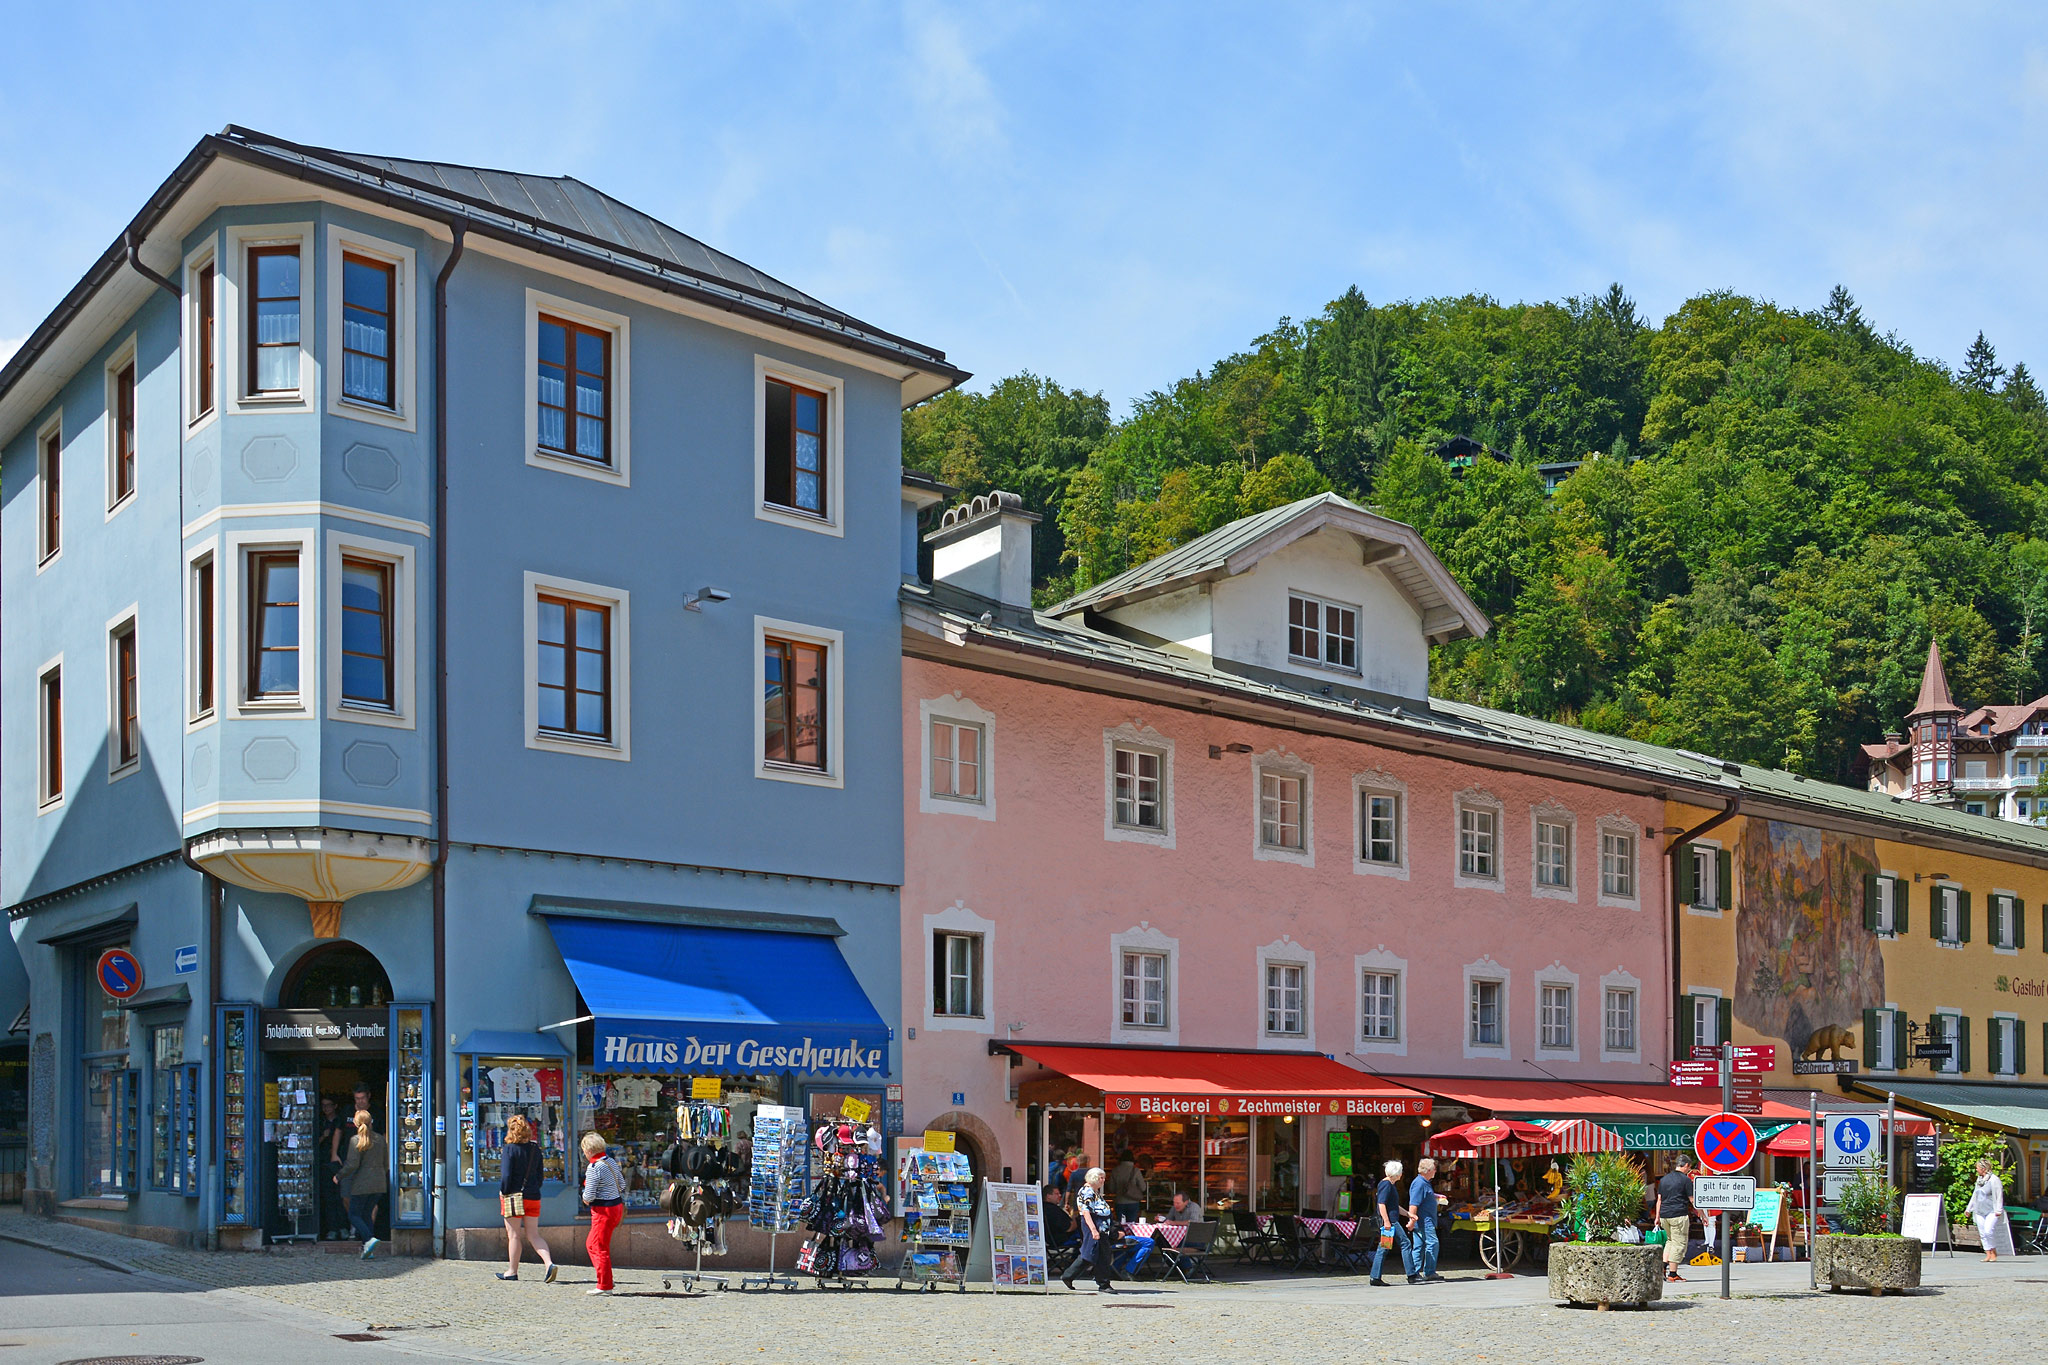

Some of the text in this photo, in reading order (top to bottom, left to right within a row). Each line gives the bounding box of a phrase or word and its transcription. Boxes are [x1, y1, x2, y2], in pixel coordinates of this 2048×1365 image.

[2012, 976, 2045, 998] Gasthof
[265, 1023, 314, 1040] Holzschnitzerei
[346, 1022, 386, 1040] Zechmeister
[604, 1036, 882, 1073] Haus der Geschenke
[1793, 1060, 1849, 1074] Goldener Bär
[1140, 1096, 1406, 1114] Bäckerei Zechmeister Bäckerei
[1838, 1155, 1866, 1165] ZONE
[1703, 1181, 1746, 1192] gilt für den
[1697, 1194, 1751, 1203] gesamten Platz
